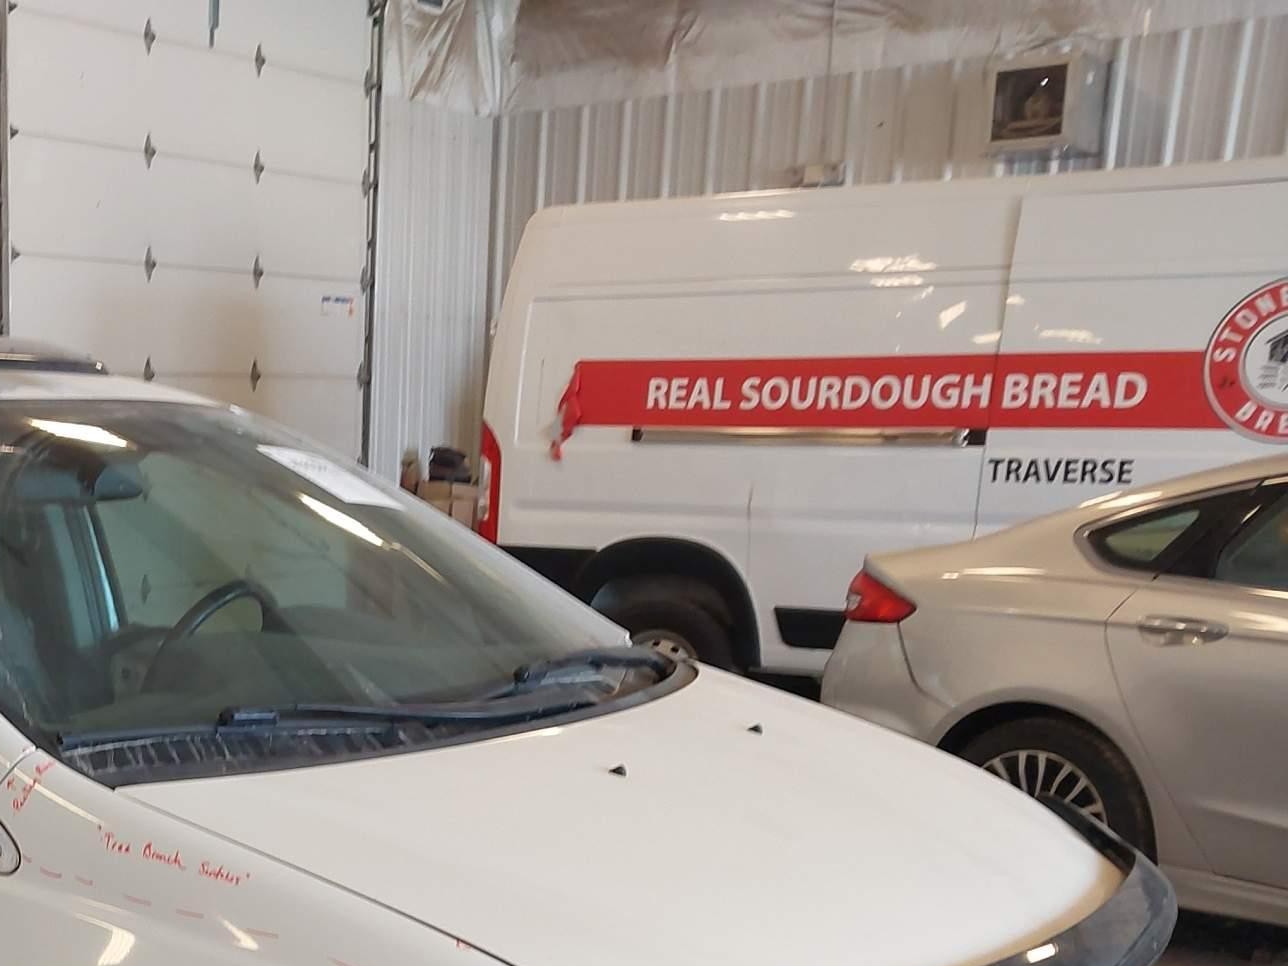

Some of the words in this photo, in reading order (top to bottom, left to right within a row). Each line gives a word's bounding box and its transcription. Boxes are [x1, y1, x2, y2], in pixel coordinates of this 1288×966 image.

[646, 377, 731, 410] REAL
[739, 373, 993, 410] SOURDOUGH
[1001, 372, 1148, 409] BREAD
[988, 458, 1134, 484] TRAVERSE
